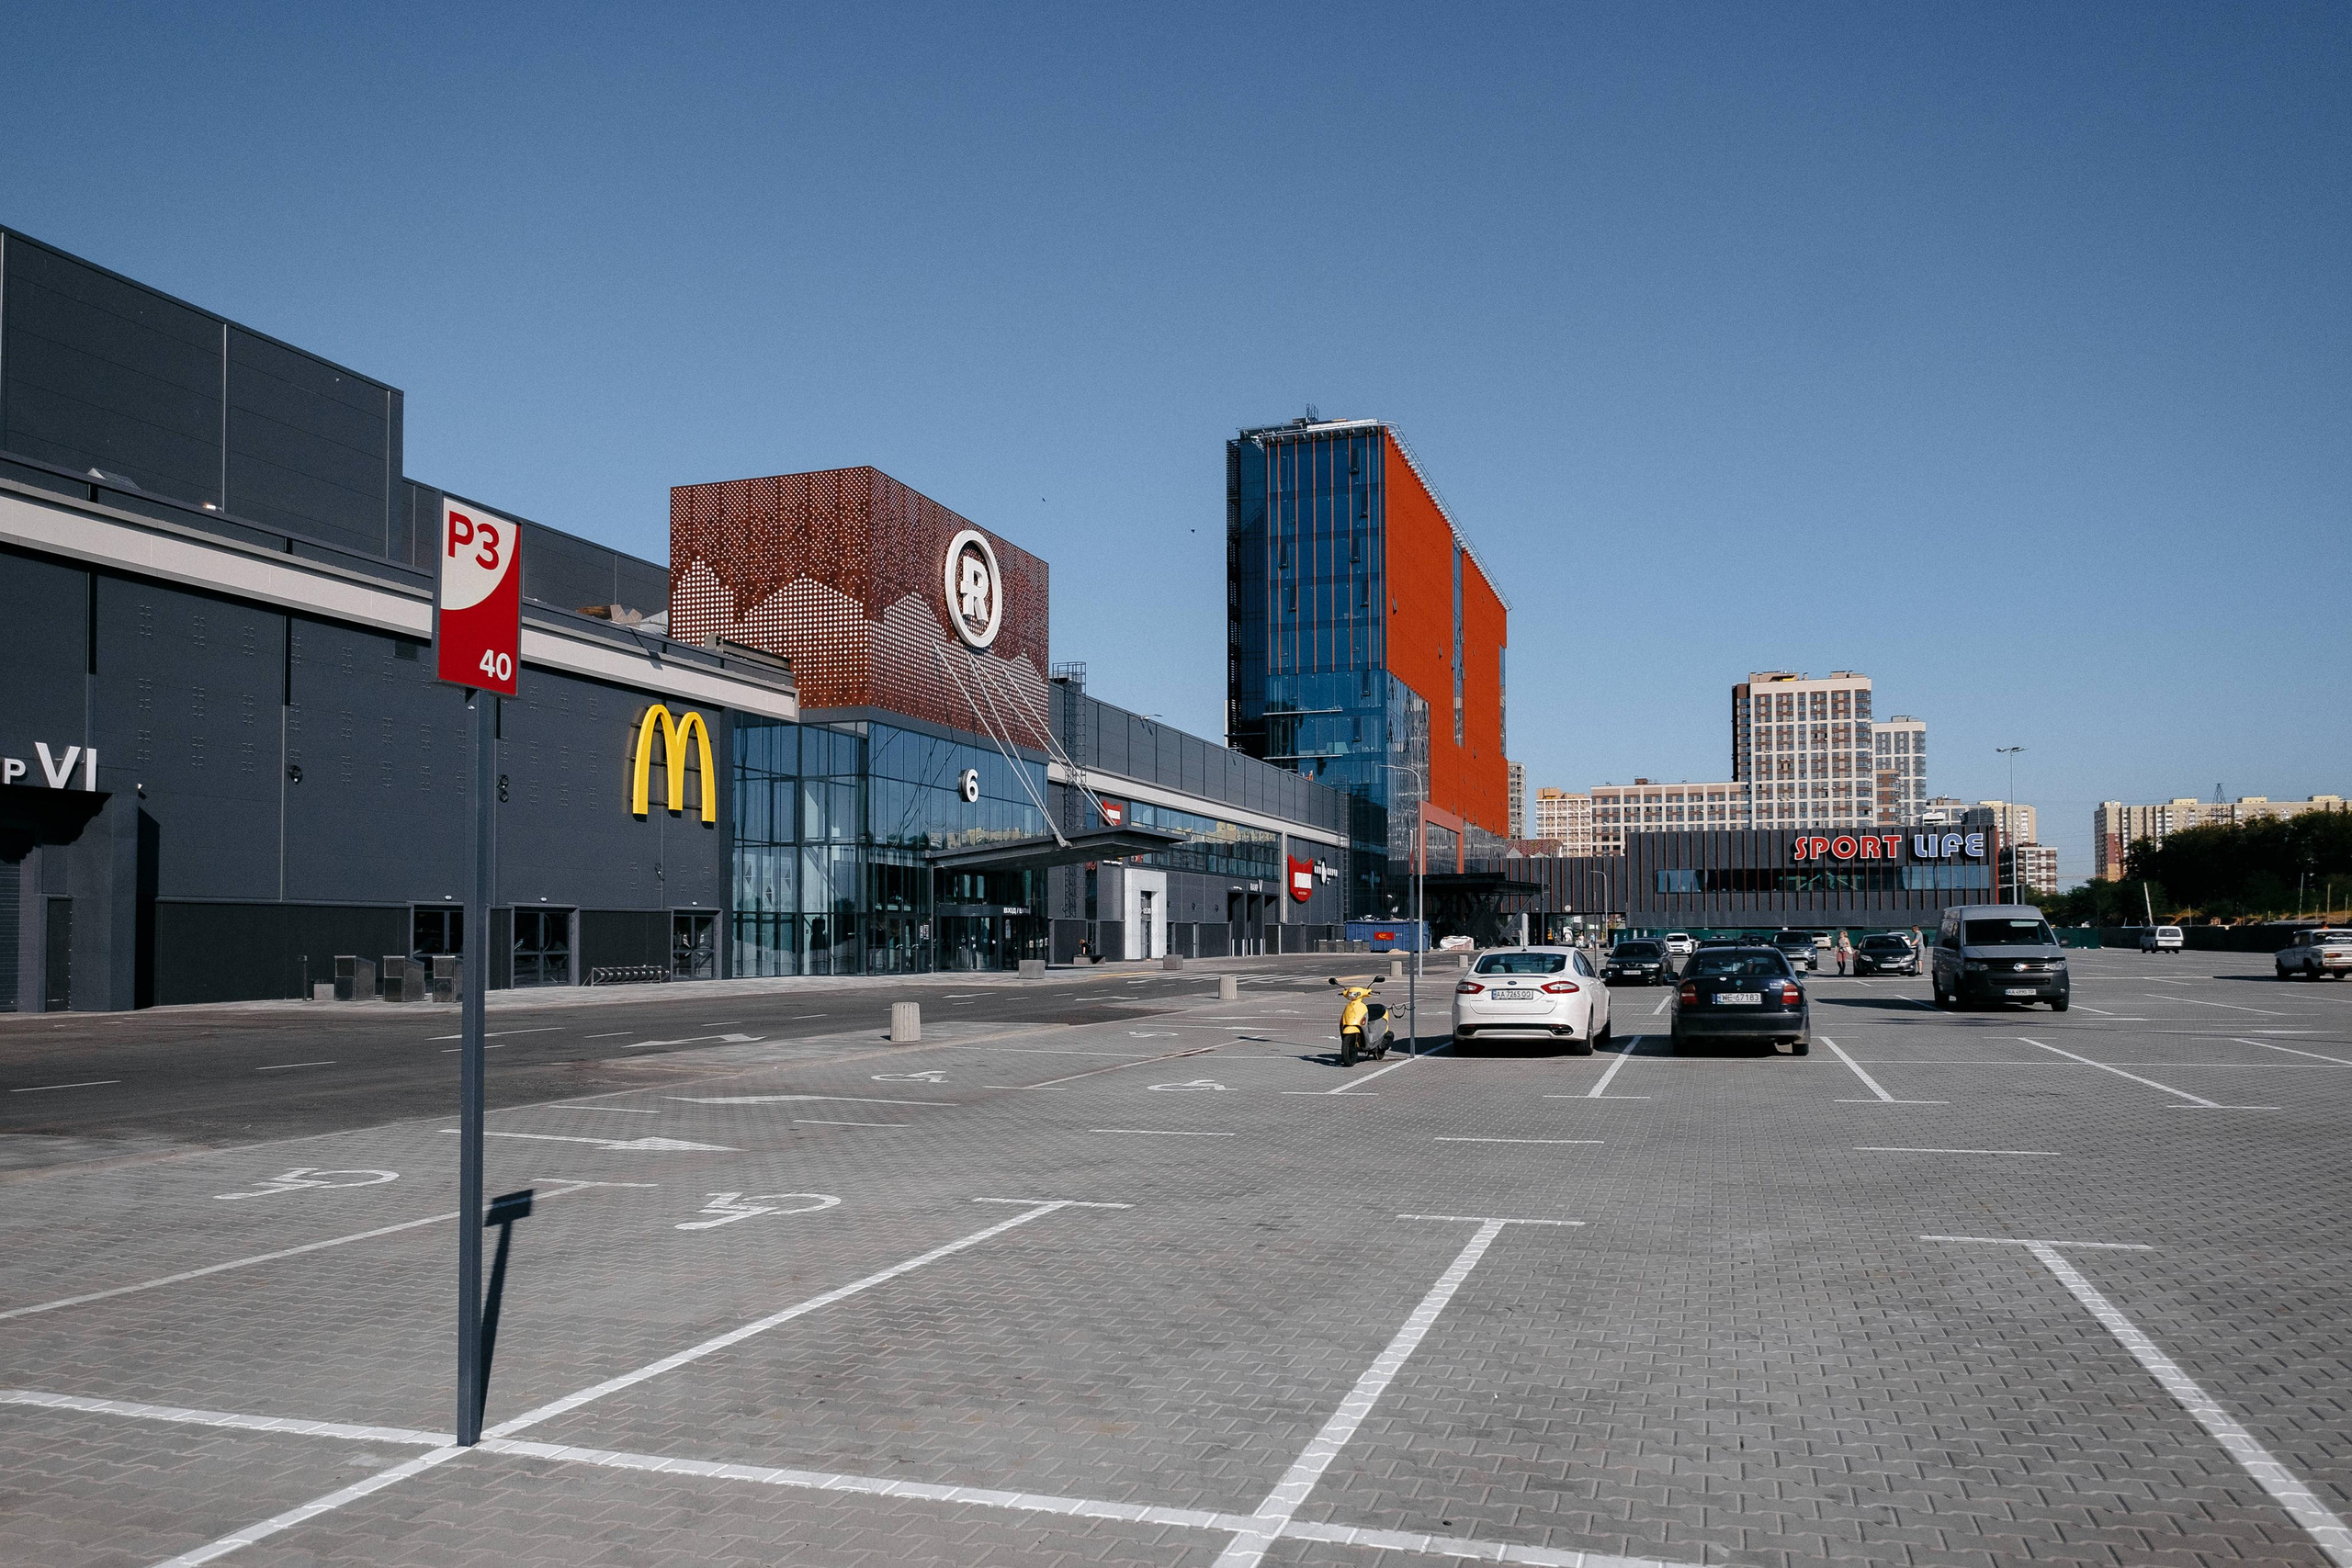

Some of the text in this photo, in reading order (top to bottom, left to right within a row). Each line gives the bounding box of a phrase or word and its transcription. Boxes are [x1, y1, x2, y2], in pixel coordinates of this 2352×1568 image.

[448, 511, 499, 570] P3
[960, 556, 989, 623] R
[480, 649, 512, 681] 40
[34, 741, 97, 792] VI
[963, 769, 979, 803] 6
[1794, 833, 1984, 861] SPORT LIFE
[1722, 994, 1759, 1002] WE 67183
